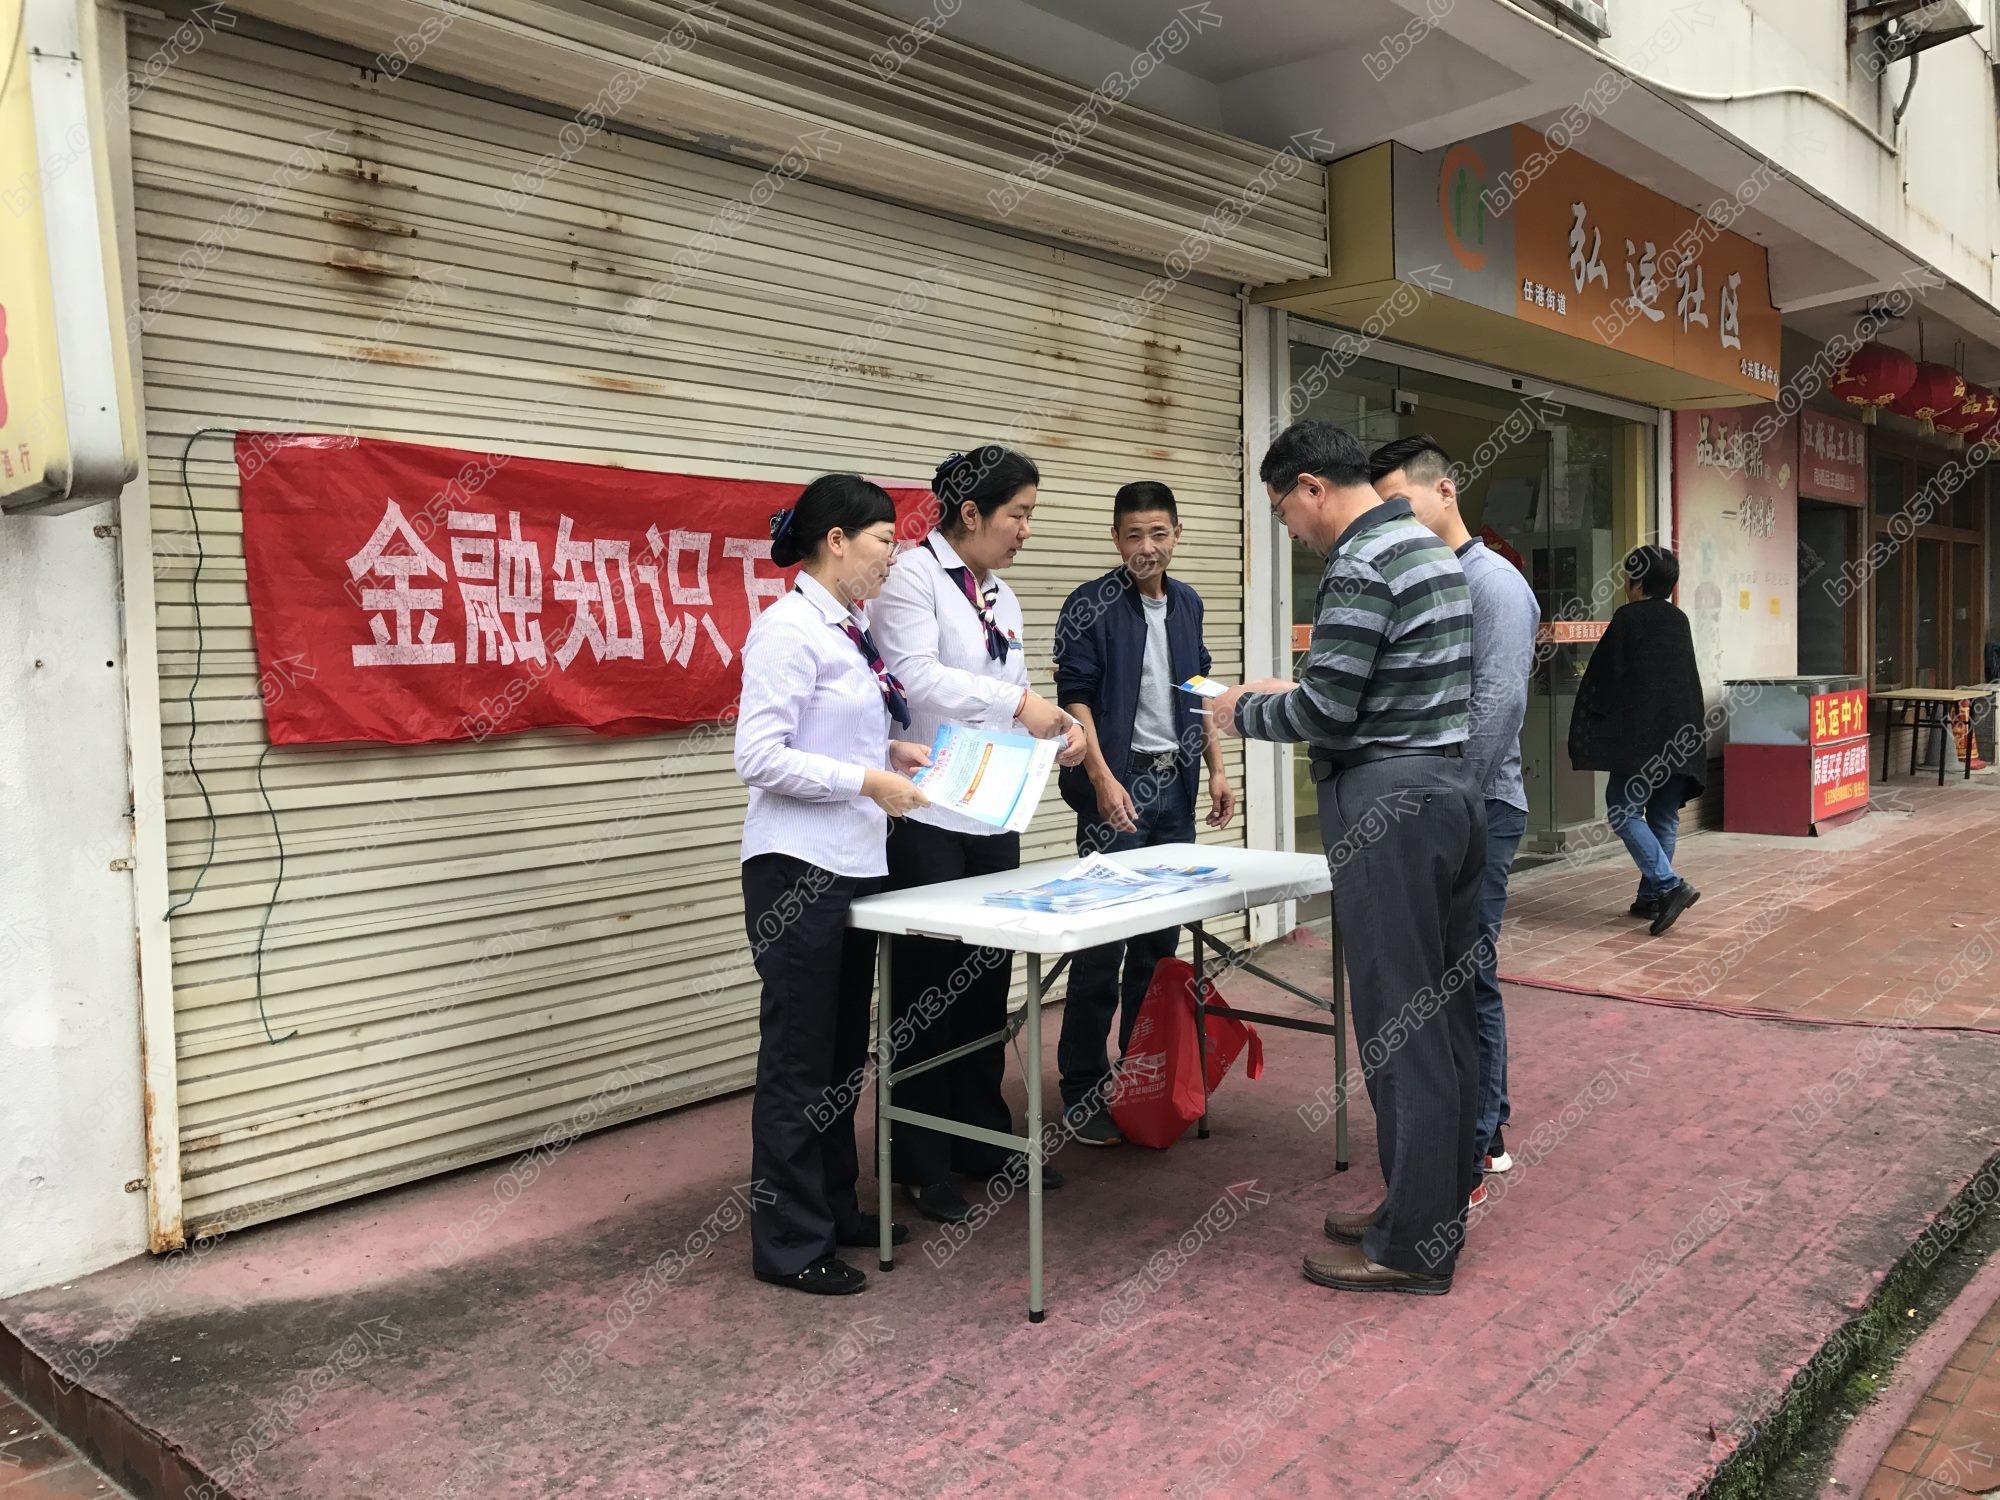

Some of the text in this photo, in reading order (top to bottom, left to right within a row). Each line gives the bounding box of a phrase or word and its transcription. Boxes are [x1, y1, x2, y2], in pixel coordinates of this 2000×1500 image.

[1522, 277, 1567, 316] 任港街道
[1740, 358, 1780, 387] 公共服务中心
[1815, 694, 1864, 740] 弘运中介
[1813, 744, 1867, 787] 房屋买卖 房屋租赁
